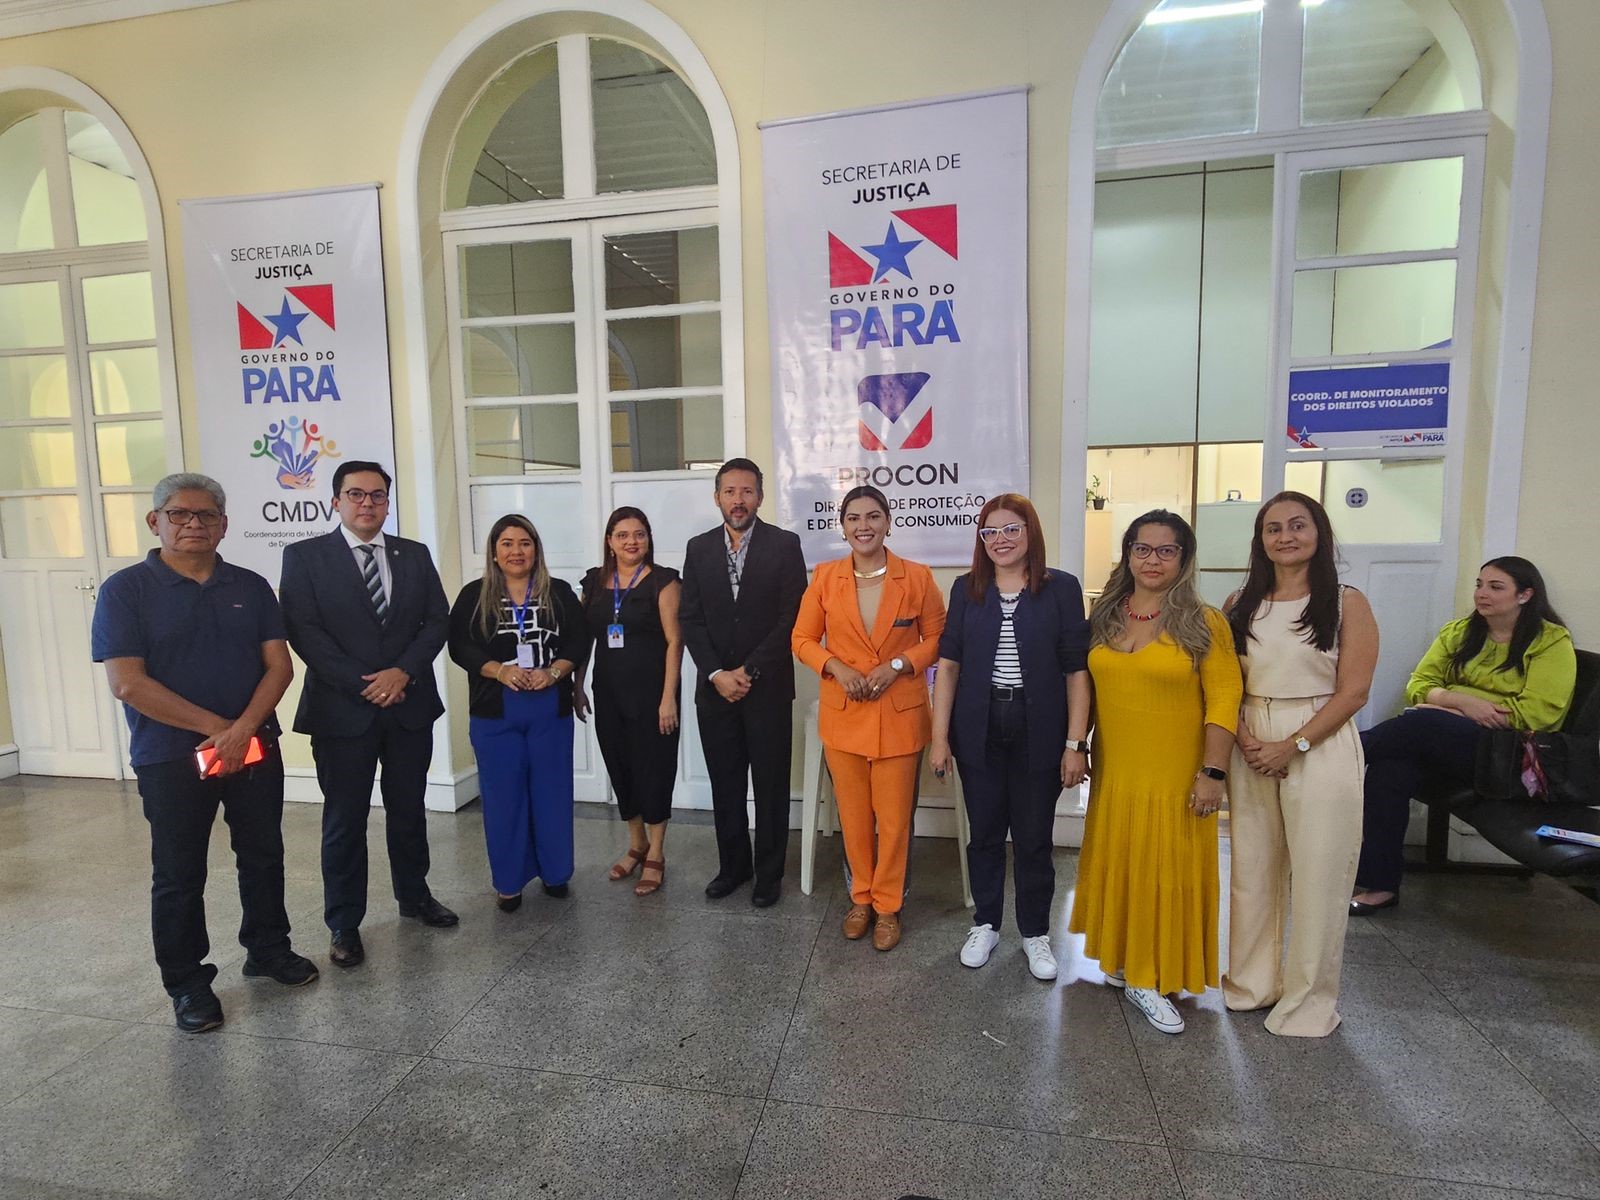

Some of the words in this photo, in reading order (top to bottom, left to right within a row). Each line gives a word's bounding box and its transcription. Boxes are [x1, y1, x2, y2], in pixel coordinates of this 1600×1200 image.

[822, 158, 931, 186] SECRETARIA
[936, 153, 961, 171] DE
[852, 181, 931, 204] JUSTIÇA
[231, 243, 312, 262] SECRETARIA
[316, 241, 334, 255] DE
[255, 264, 313, 281] JUSTIÇA
[830, 287, 919, 305] GOVERNO
[930, 283, 955, 296] DO
[241, 352, 309, 364] GOVERNO
[316, 350, 335, 361] DO
[1291, 391, 1332, 402] COORD.
[1334, 391, 1348, 399] DE
[1350, 386, 1448, 399] MONITORAMENTO
[1303, 403, 1326, 412] DOS
[1328, 401, 1376, 411] DIREITOS
[1378, 398, 1434, 408] VIOLADOS
[838, 462, 959, 487] PROCON
[889, 498, 905, 510] DE
[909, 493, 986, 511] PROTEÇÃO
[262, 500, 334, 523] CMDV
[807, 519, 815, 531] E
[895, 513, 981, 528] CONSUMIDO
[244, 530, 295, 538] Coordenadoria
